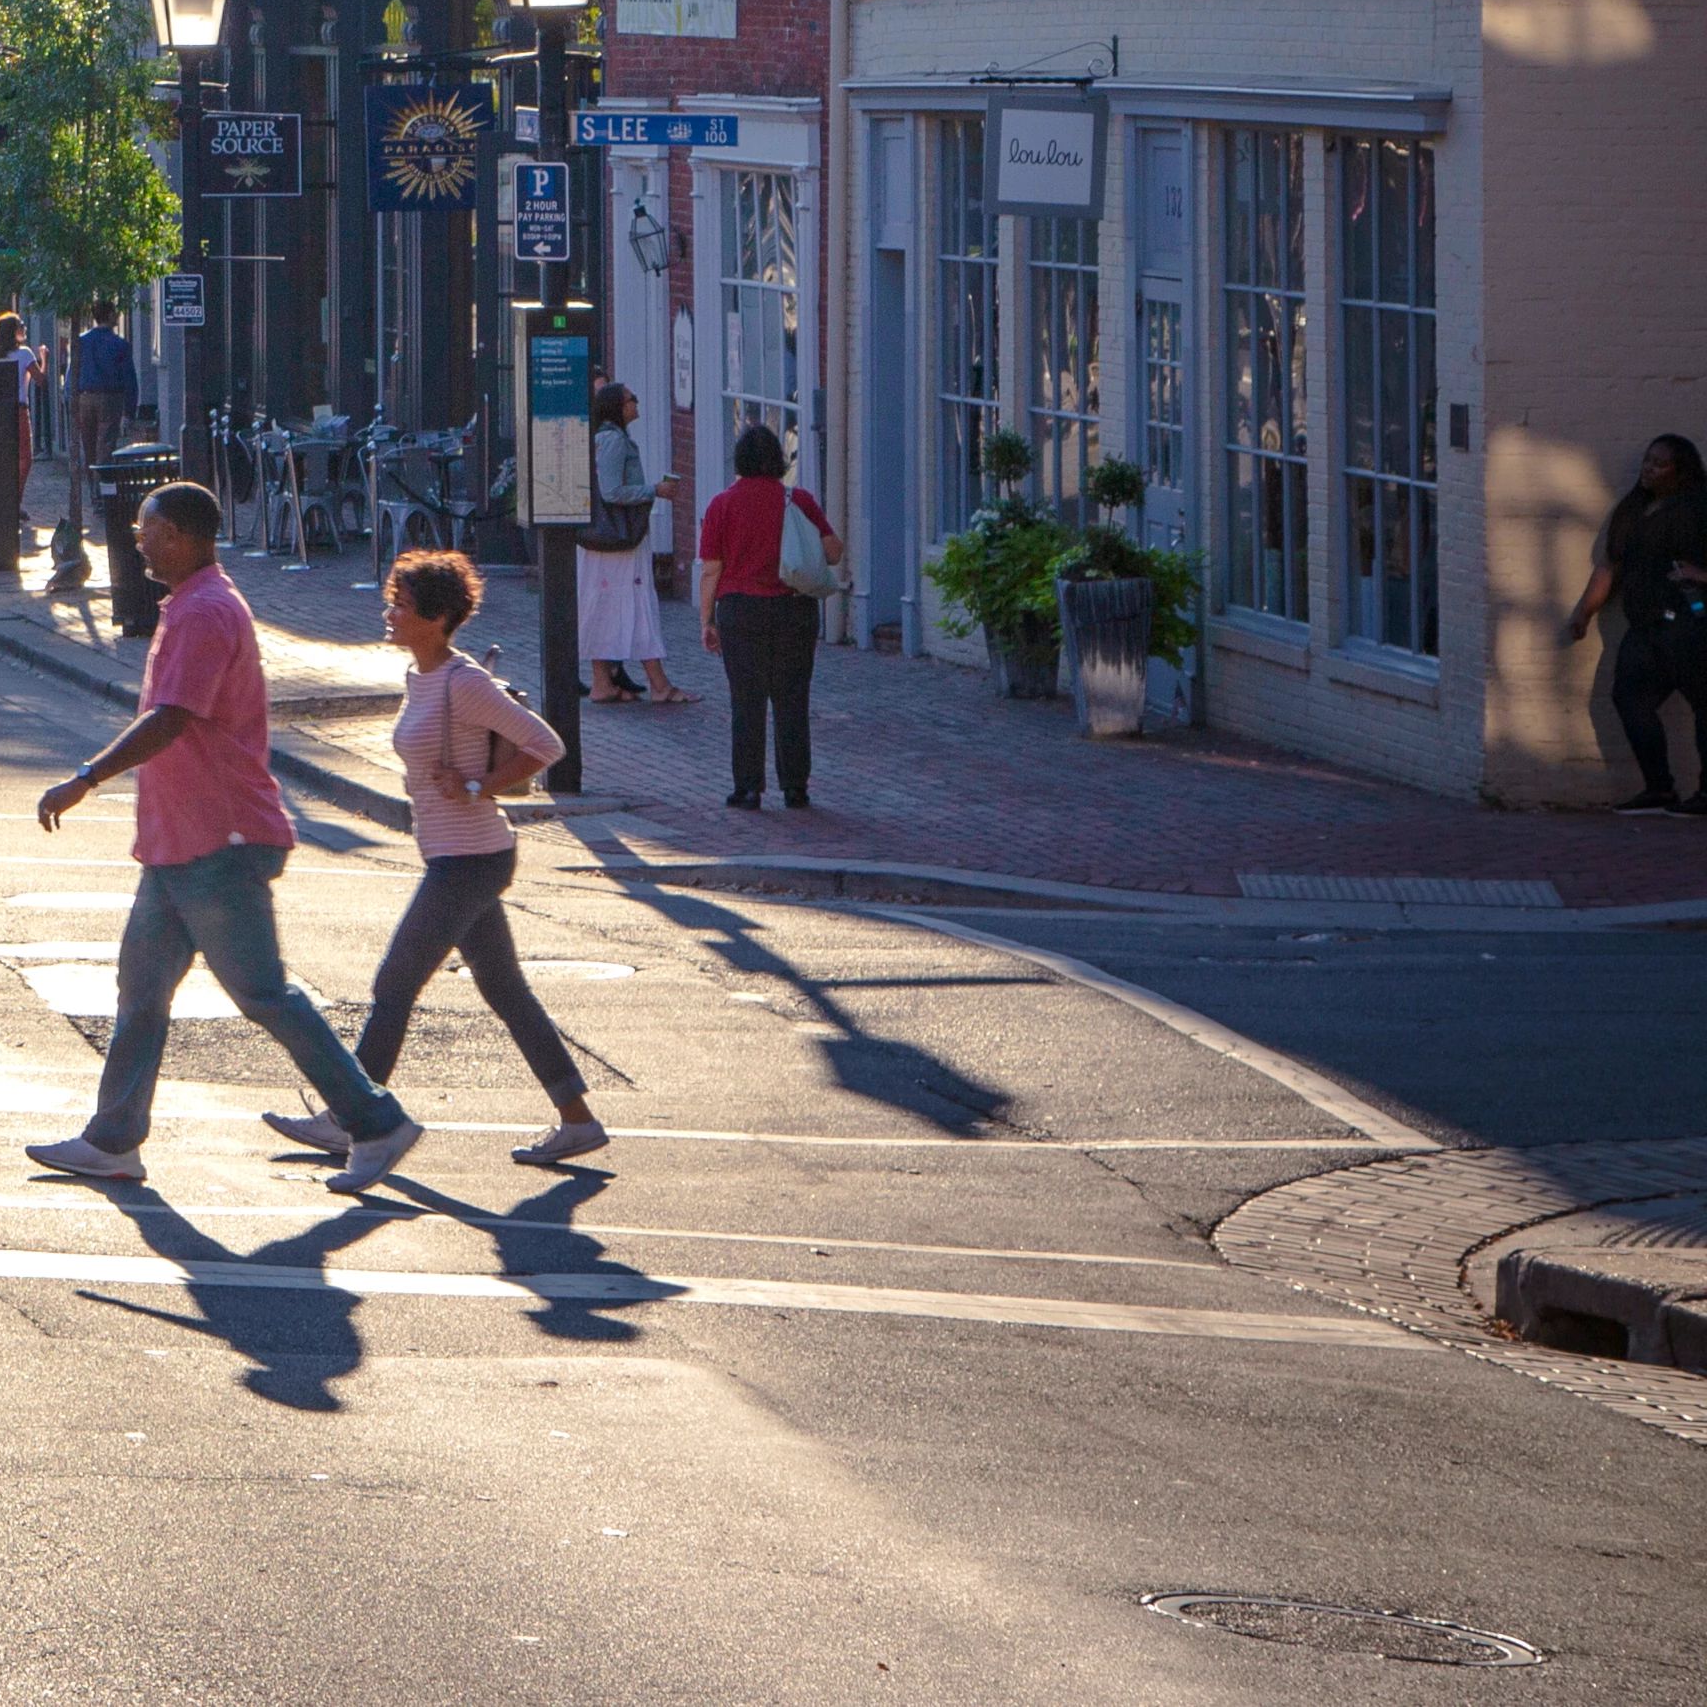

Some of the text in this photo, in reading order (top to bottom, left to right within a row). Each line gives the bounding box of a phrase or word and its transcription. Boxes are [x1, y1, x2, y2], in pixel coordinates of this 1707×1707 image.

[217, 120, 278, 137] PAPER
[582, 117, 649, 142] S LEE
[710, 119, 725, 131] ST
[210, 137, 284, 154] SOURCE
[704, 131, 728, 144] 100
[1008, 137, 1084, 167] lou lou
[532, 168, 550, 197] P
[525, 200, 558, 211] 2 HOUR
[518, 212, 566, 222] PAY PARKING
